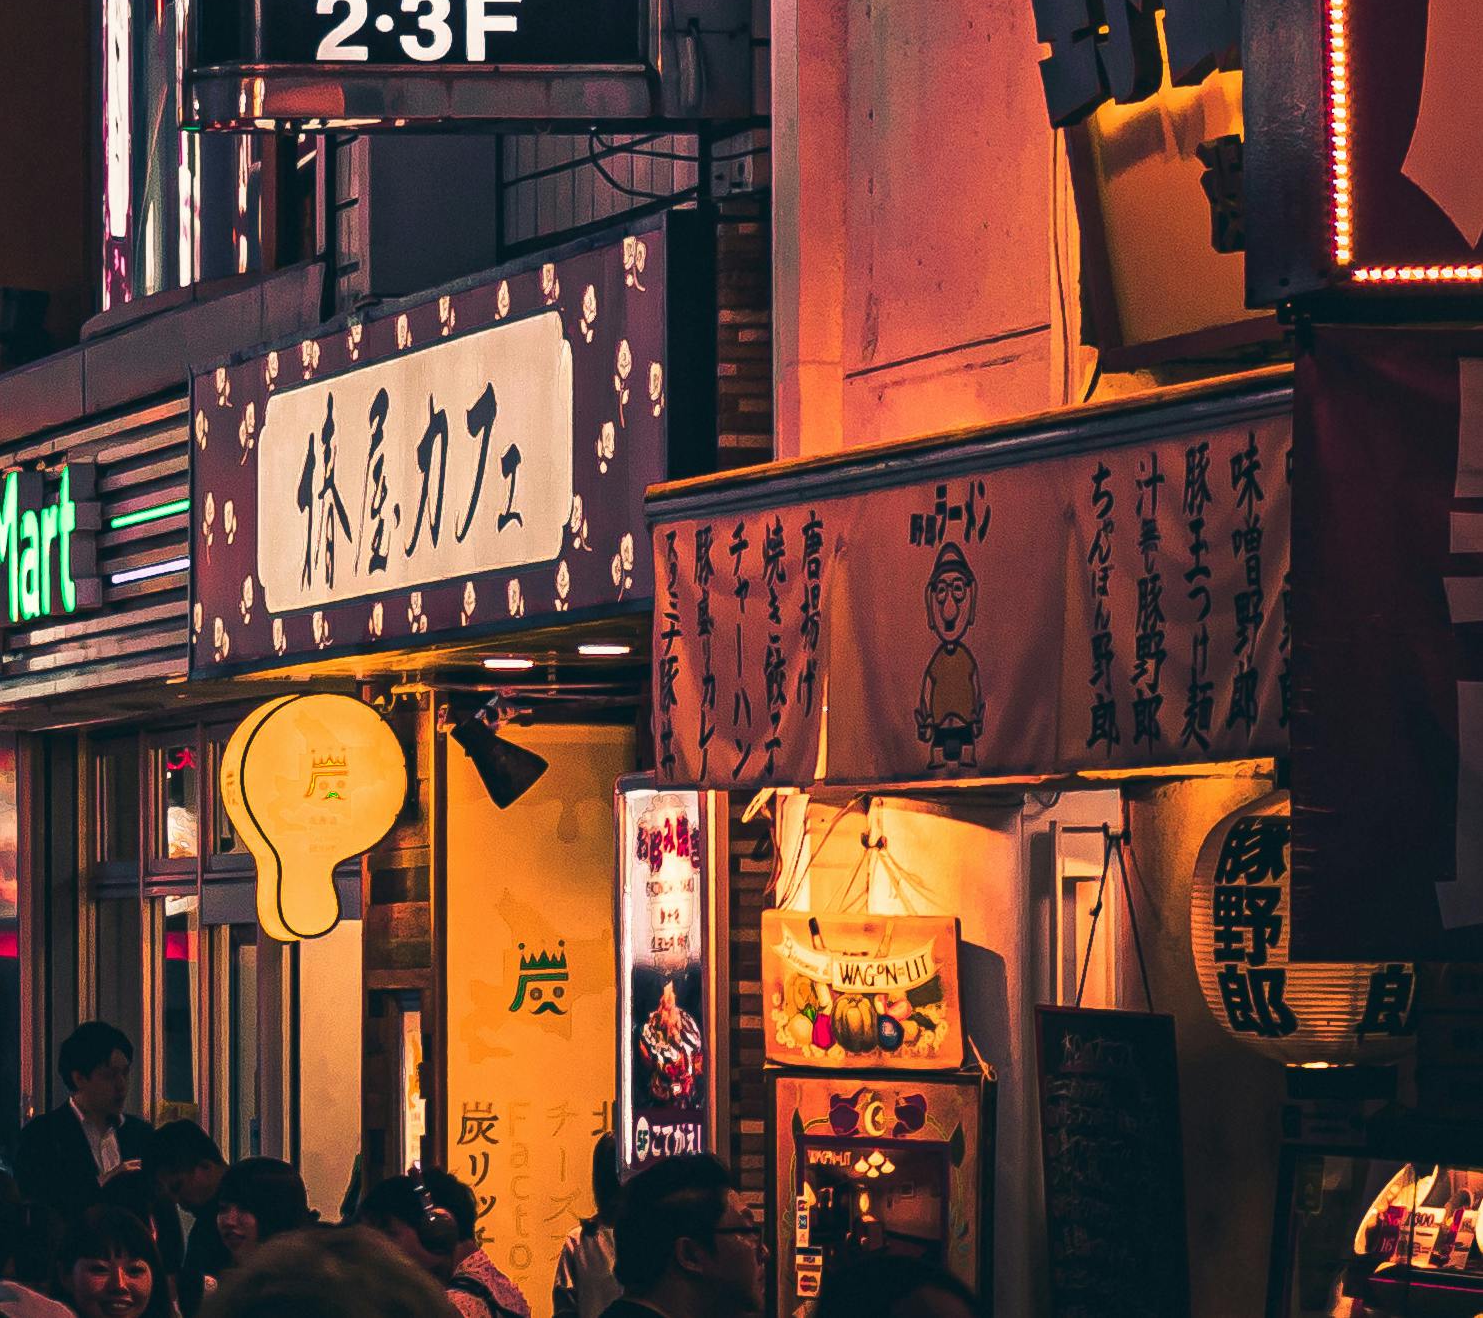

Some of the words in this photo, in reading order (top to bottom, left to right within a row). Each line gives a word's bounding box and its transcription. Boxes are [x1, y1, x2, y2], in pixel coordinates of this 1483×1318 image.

[728, 519, 751, 782] チャーハン
[795, 509, 824, 719] 唐揚げ
[1086, 463, 1124, 750] ちゃんぽん野郎
[1225, 431, 1266, 734] 味噌野郎
